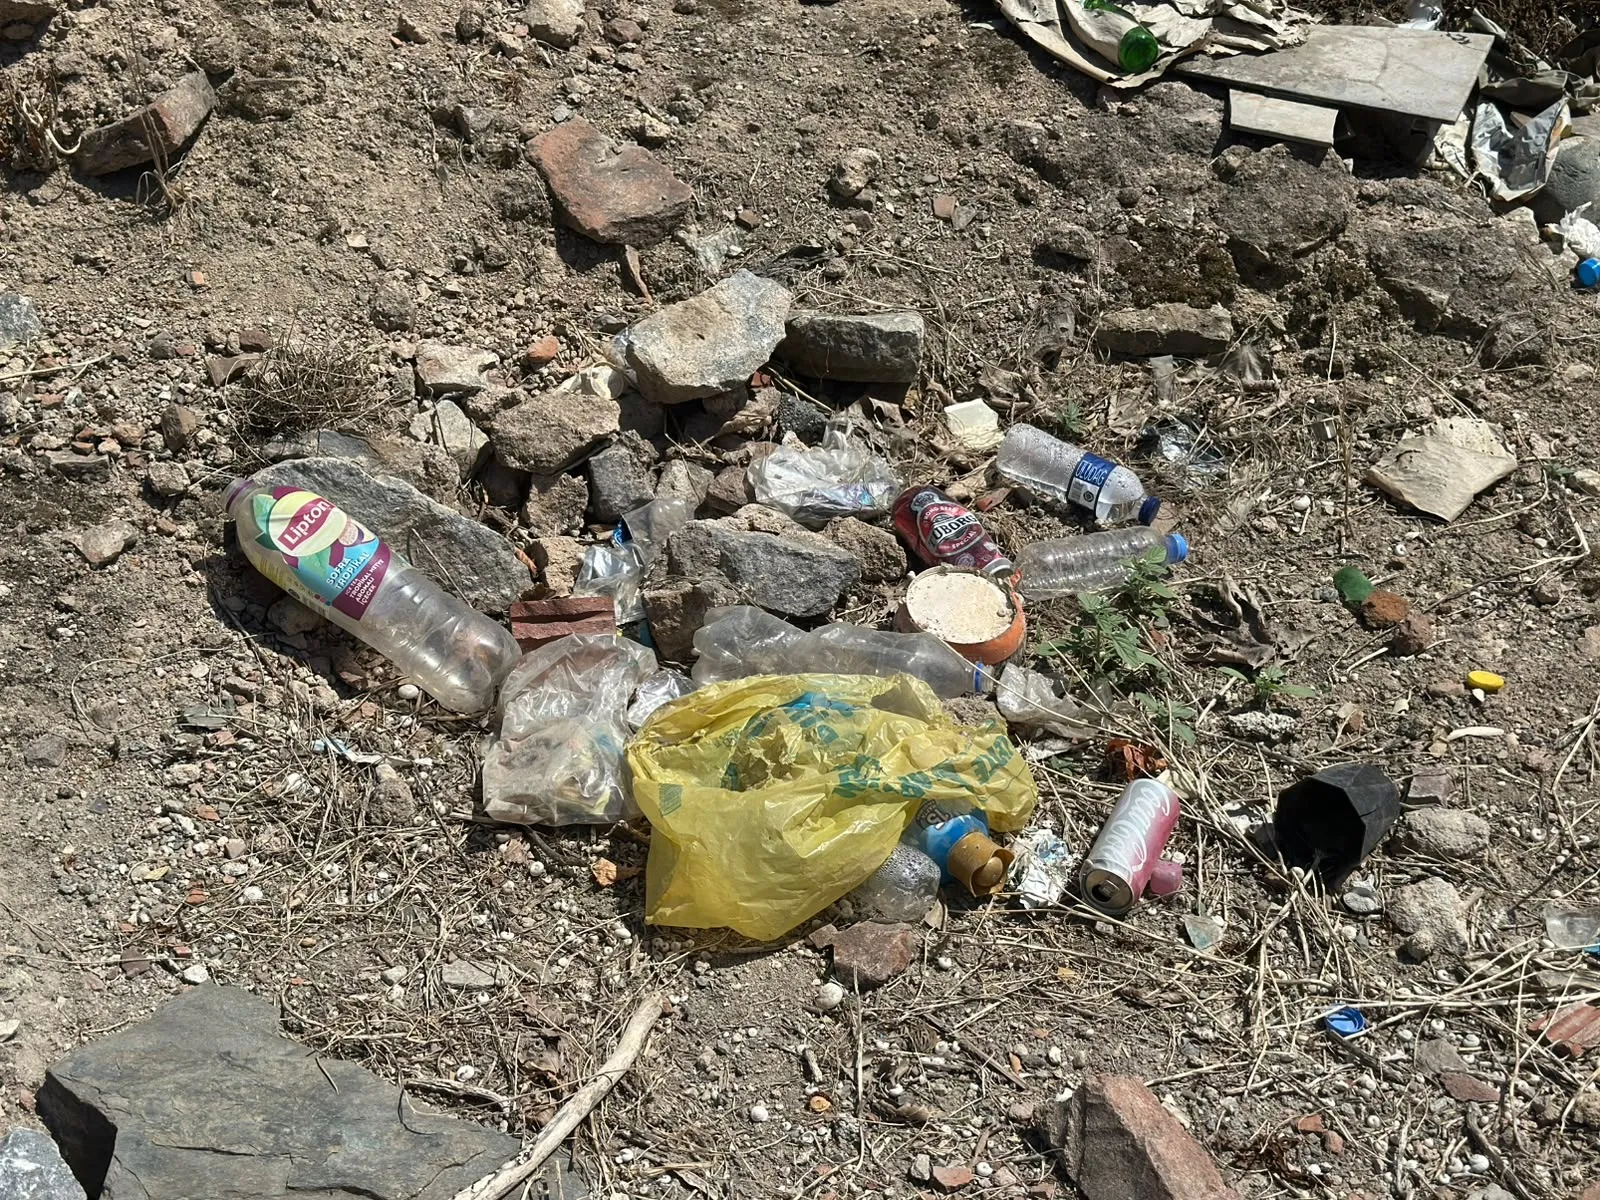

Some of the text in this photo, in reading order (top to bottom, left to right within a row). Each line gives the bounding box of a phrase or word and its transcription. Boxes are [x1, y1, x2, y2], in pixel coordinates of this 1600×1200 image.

[283, 500, 331, 545] Lipton
[327, 557, 351, 585] SOFRA
[355, 576, 375, 602] AROMALI
